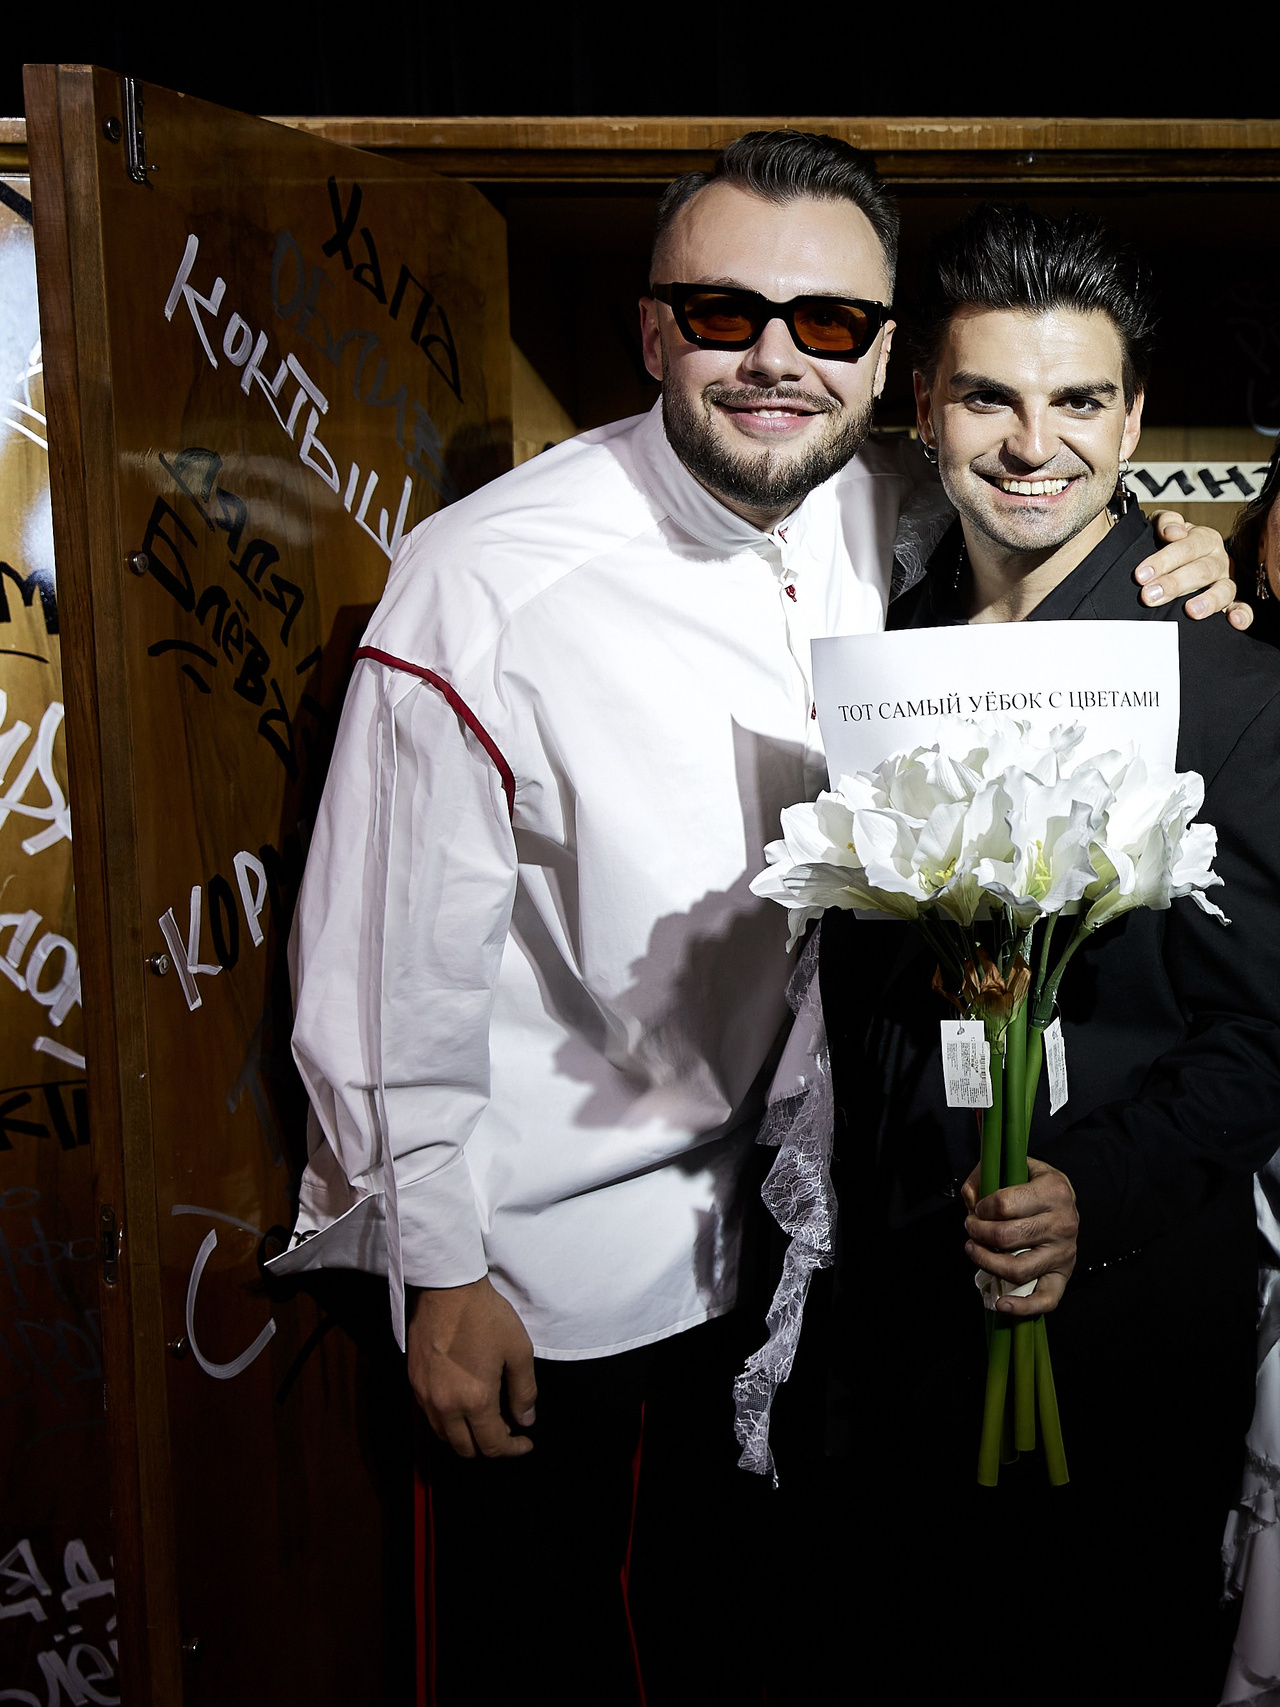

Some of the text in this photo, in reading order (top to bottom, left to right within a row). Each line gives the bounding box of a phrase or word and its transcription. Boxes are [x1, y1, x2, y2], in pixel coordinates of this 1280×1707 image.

[838, 691, 1160, 722] ТОТ САМЫЙ УЁБОК С ЦВЕТАМИ
